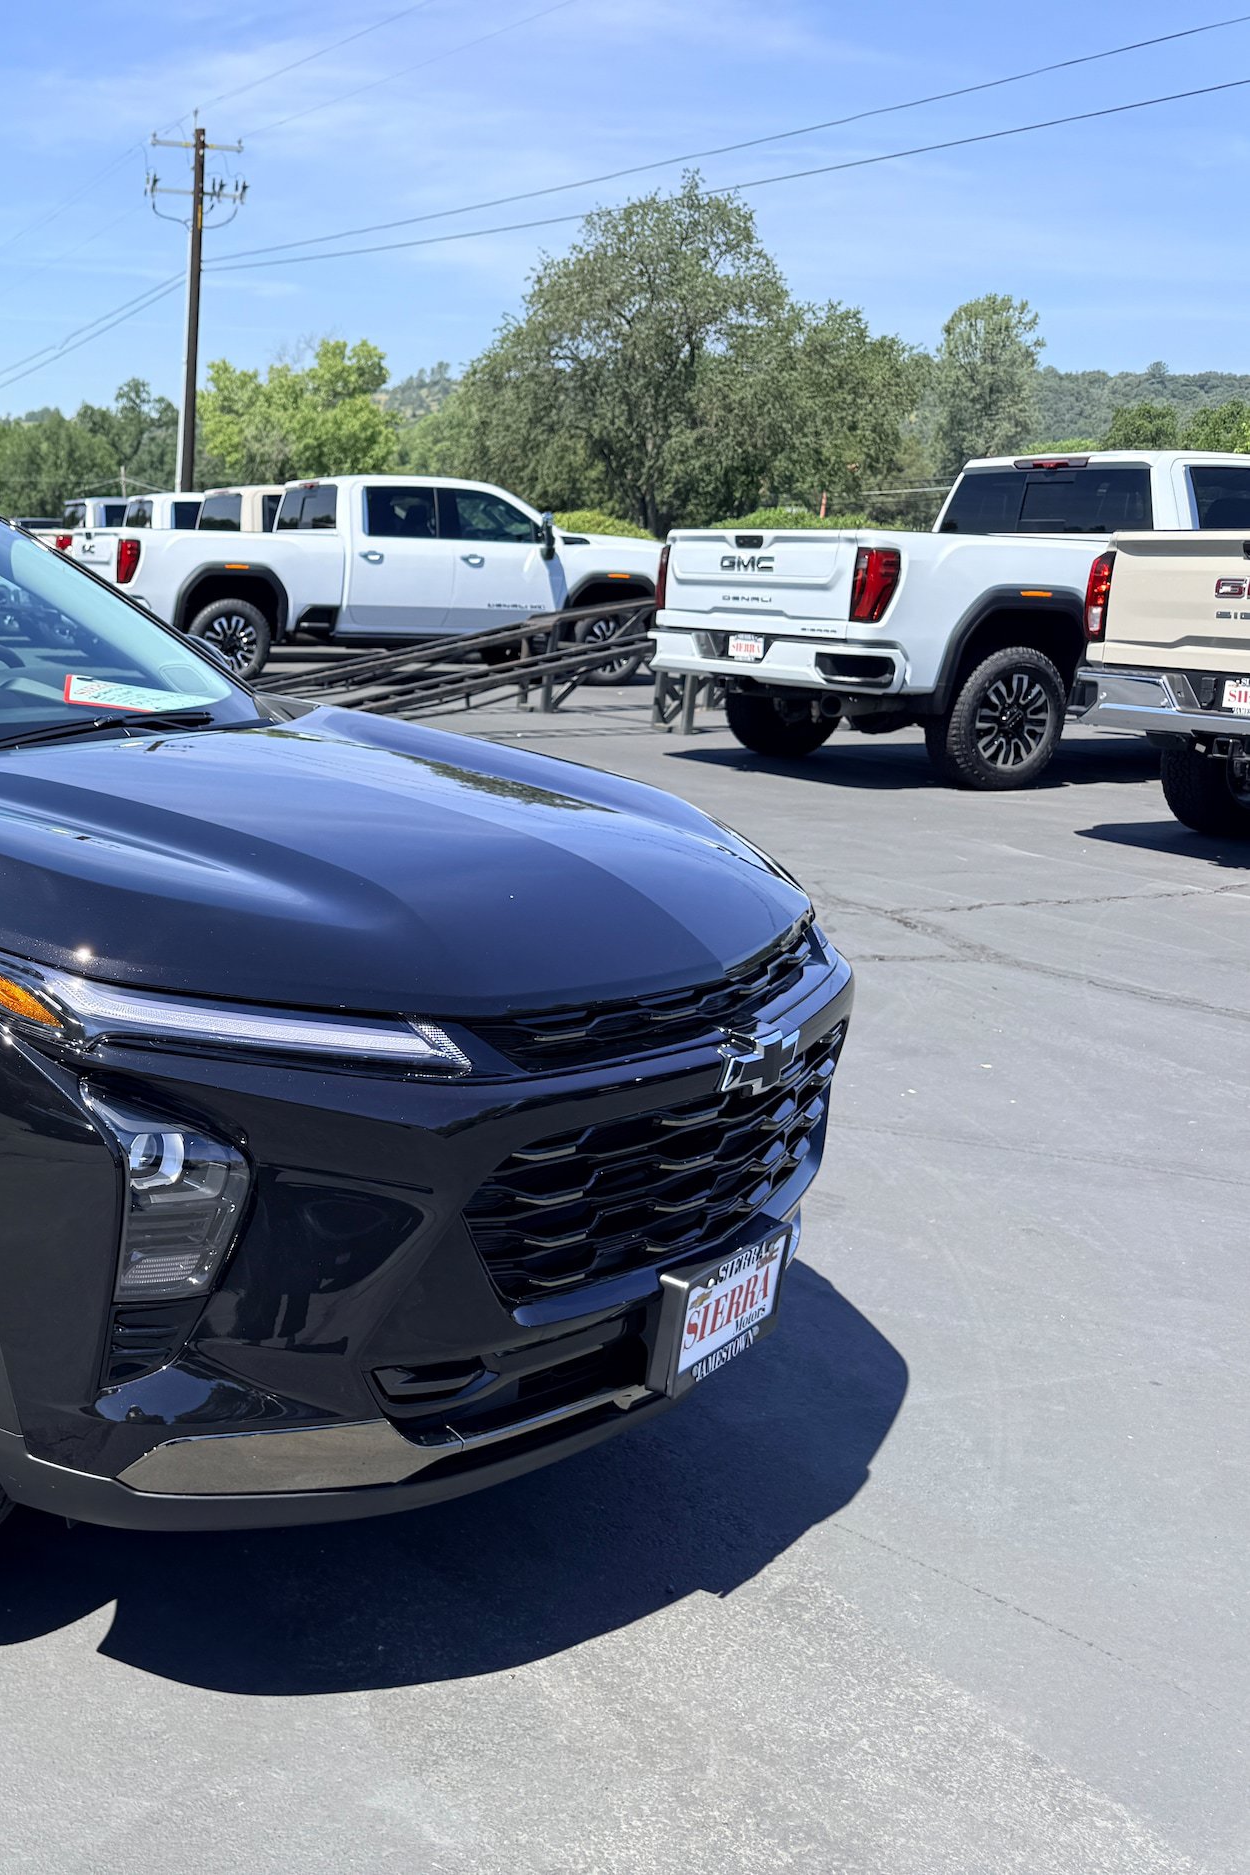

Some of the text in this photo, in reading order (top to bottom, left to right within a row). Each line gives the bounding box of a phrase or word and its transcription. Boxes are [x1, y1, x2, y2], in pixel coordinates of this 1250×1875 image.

[720, 555, 774, 572] GMC
[722, 595, 772, 603] DENALI
[1215, 577, 1250, 599] G
[731, 642, 760, 654] SIERRA
[717, 1241, 767, 1284] SIERRA
[683, 1265, 770, 1352] SIERRA
[733, 1304, 766, 1336] Motors
[695, 1328, 754, 1382] JAMESTOWN
